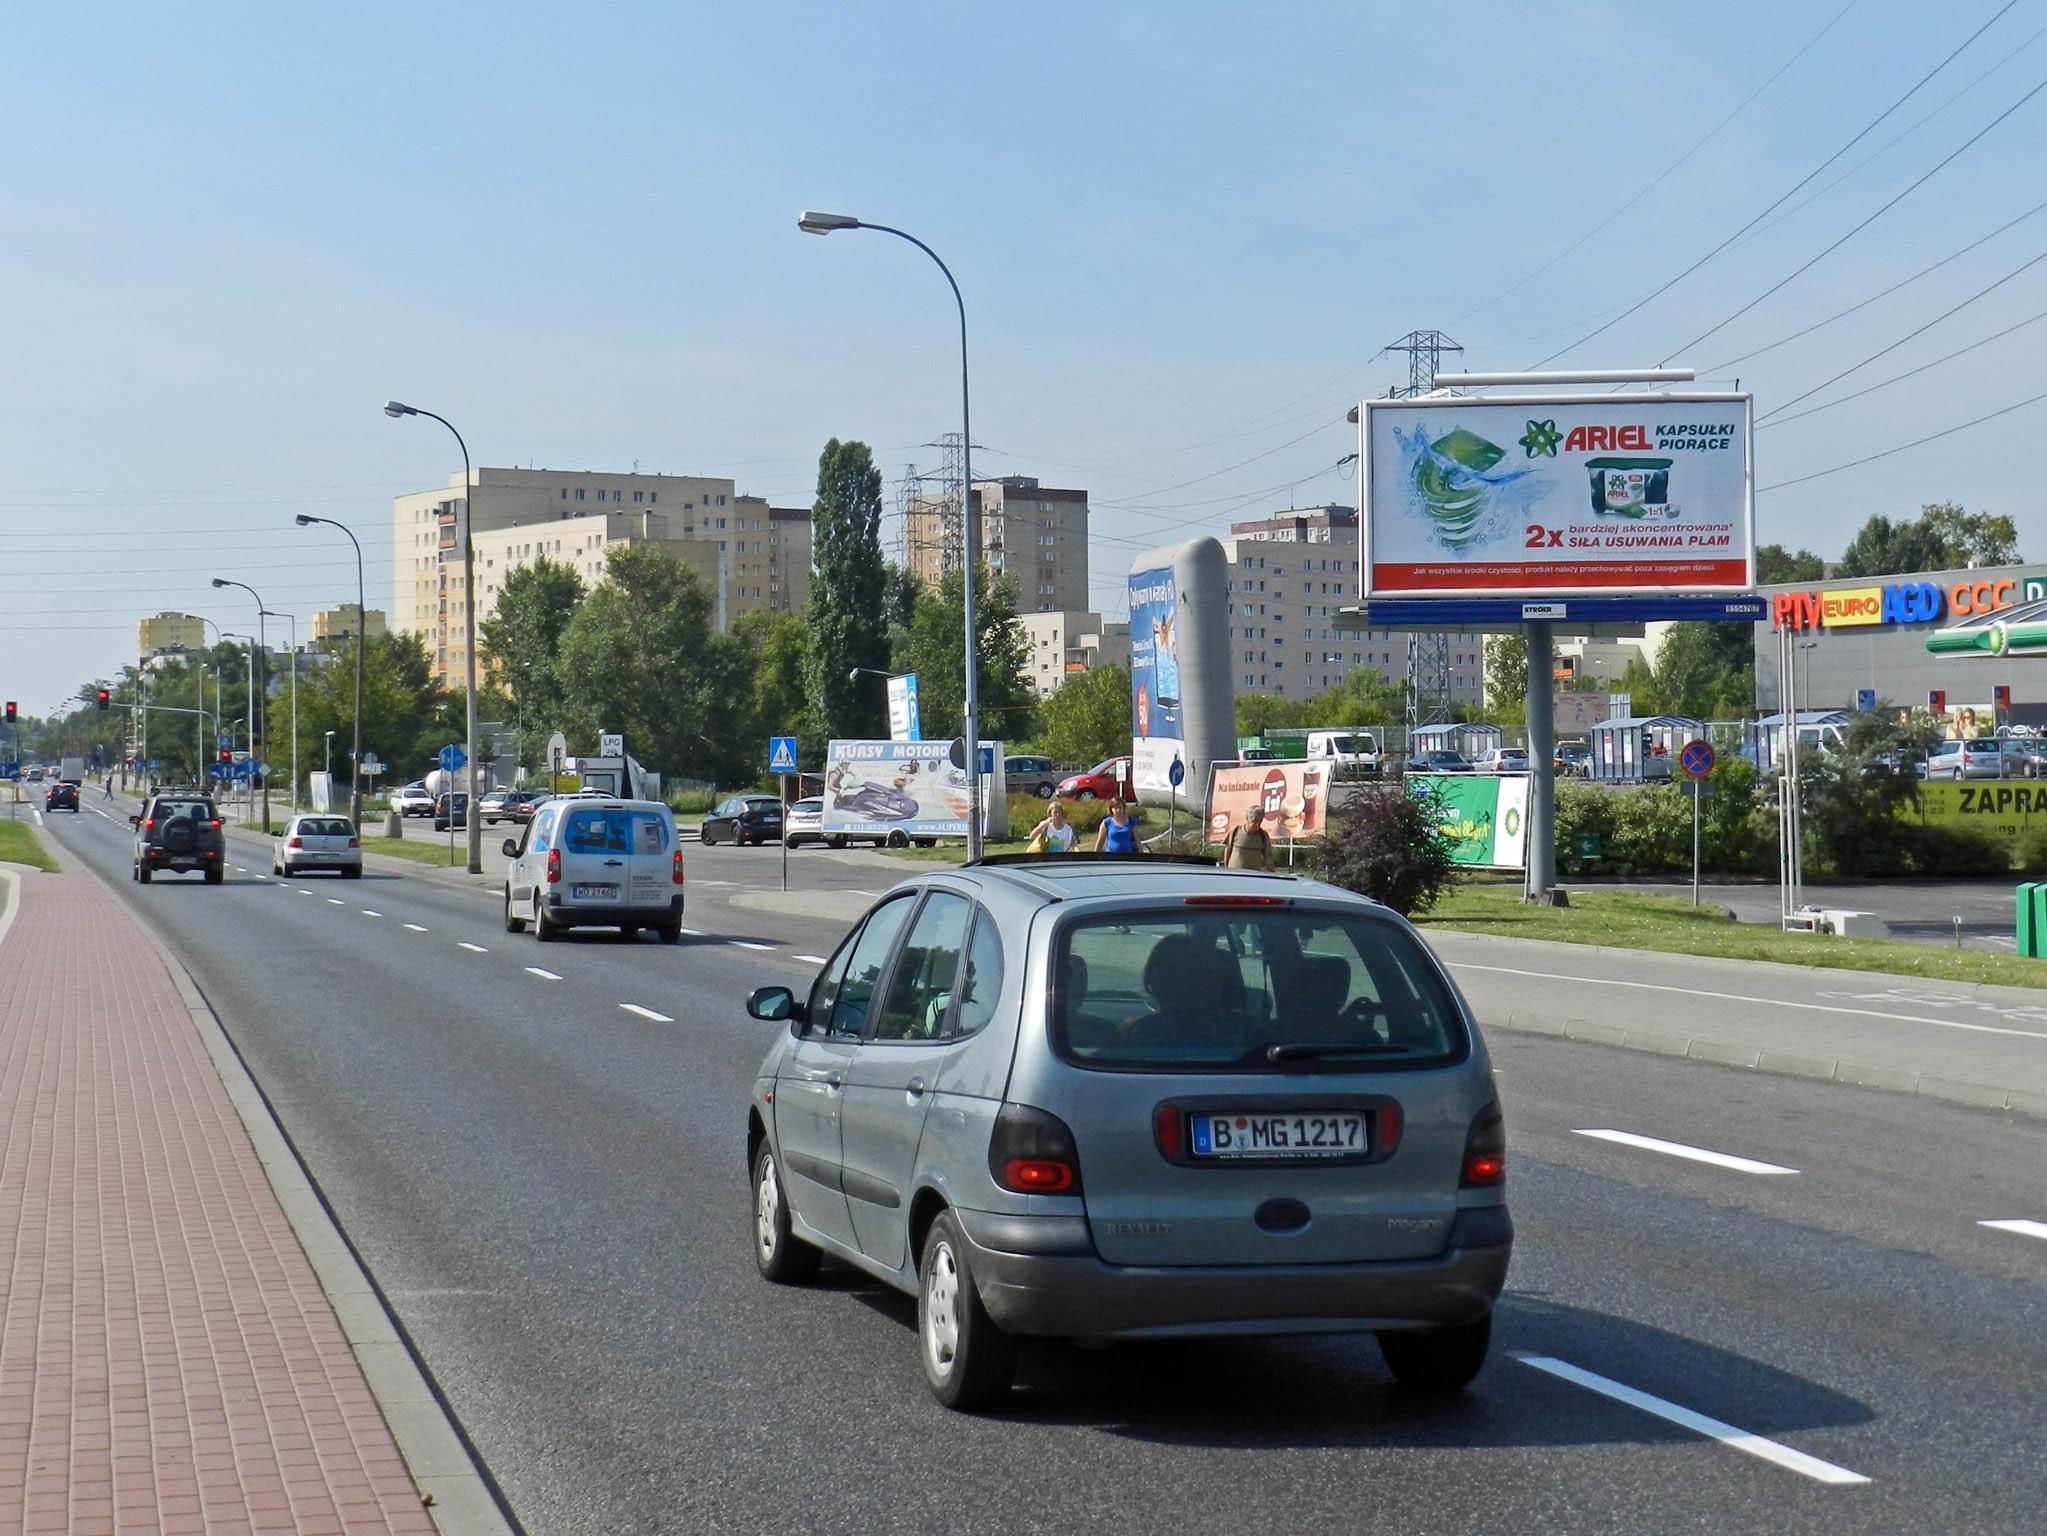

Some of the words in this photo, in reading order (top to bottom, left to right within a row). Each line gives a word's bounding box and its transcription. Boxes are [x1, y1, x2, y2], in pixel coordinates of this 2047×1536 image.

[1655, 424, 1735, 436] KAPSUŁKI
[1564, 425, 1653, 451] ARIEL
[1658, 438, 1730, 452] PIORĄCE
[1607, 490, 1630, 499] ARIEL
[1525, 524, 1564, 548] 2x
[1569, 524, 1618, 535] bardziej
[1569, 536, 1600, 548] SIŁA
[1605, 535, 1683, 548] USUWANIA
[1688, 535, 1730, 546] PLAM
[1413, 567, 1427, 575] Jak
[1428, 567, 1463, 576] wszystkie
[1525, 565, 1553, 575] produkt
[1823, 597, 1880, 617] EURO
[1882, 582, 1940, 625] AGD
[1949, 579, 2015, 616] CCC
[605, 738, 620, 746] LPG
[1213, 1120, 1233, 1148] B
